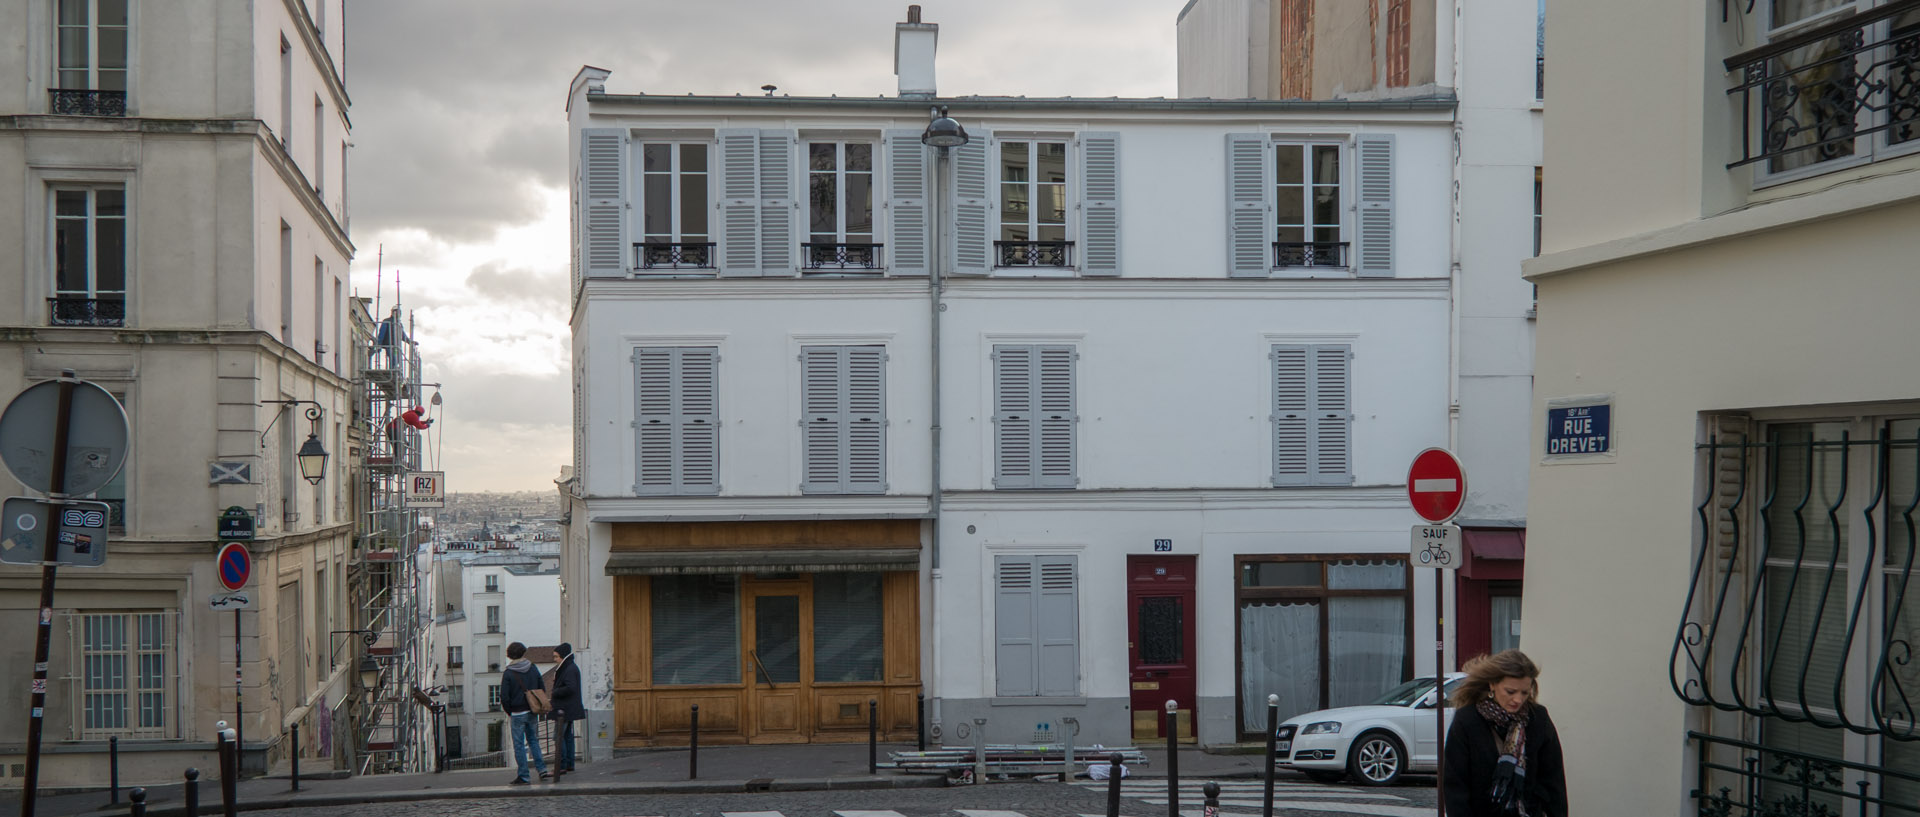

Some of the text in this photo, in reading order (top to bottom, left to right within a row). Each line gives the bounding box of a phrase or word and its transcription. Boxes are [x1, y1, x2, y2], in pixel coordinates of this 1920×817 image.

[1564, 418, 1592, 434] RUE
[1550, 436, 1606, 453] DREVET
[1422, 528, 1448, 539] SAUF
[1156, 540, 1171, 551] 29
